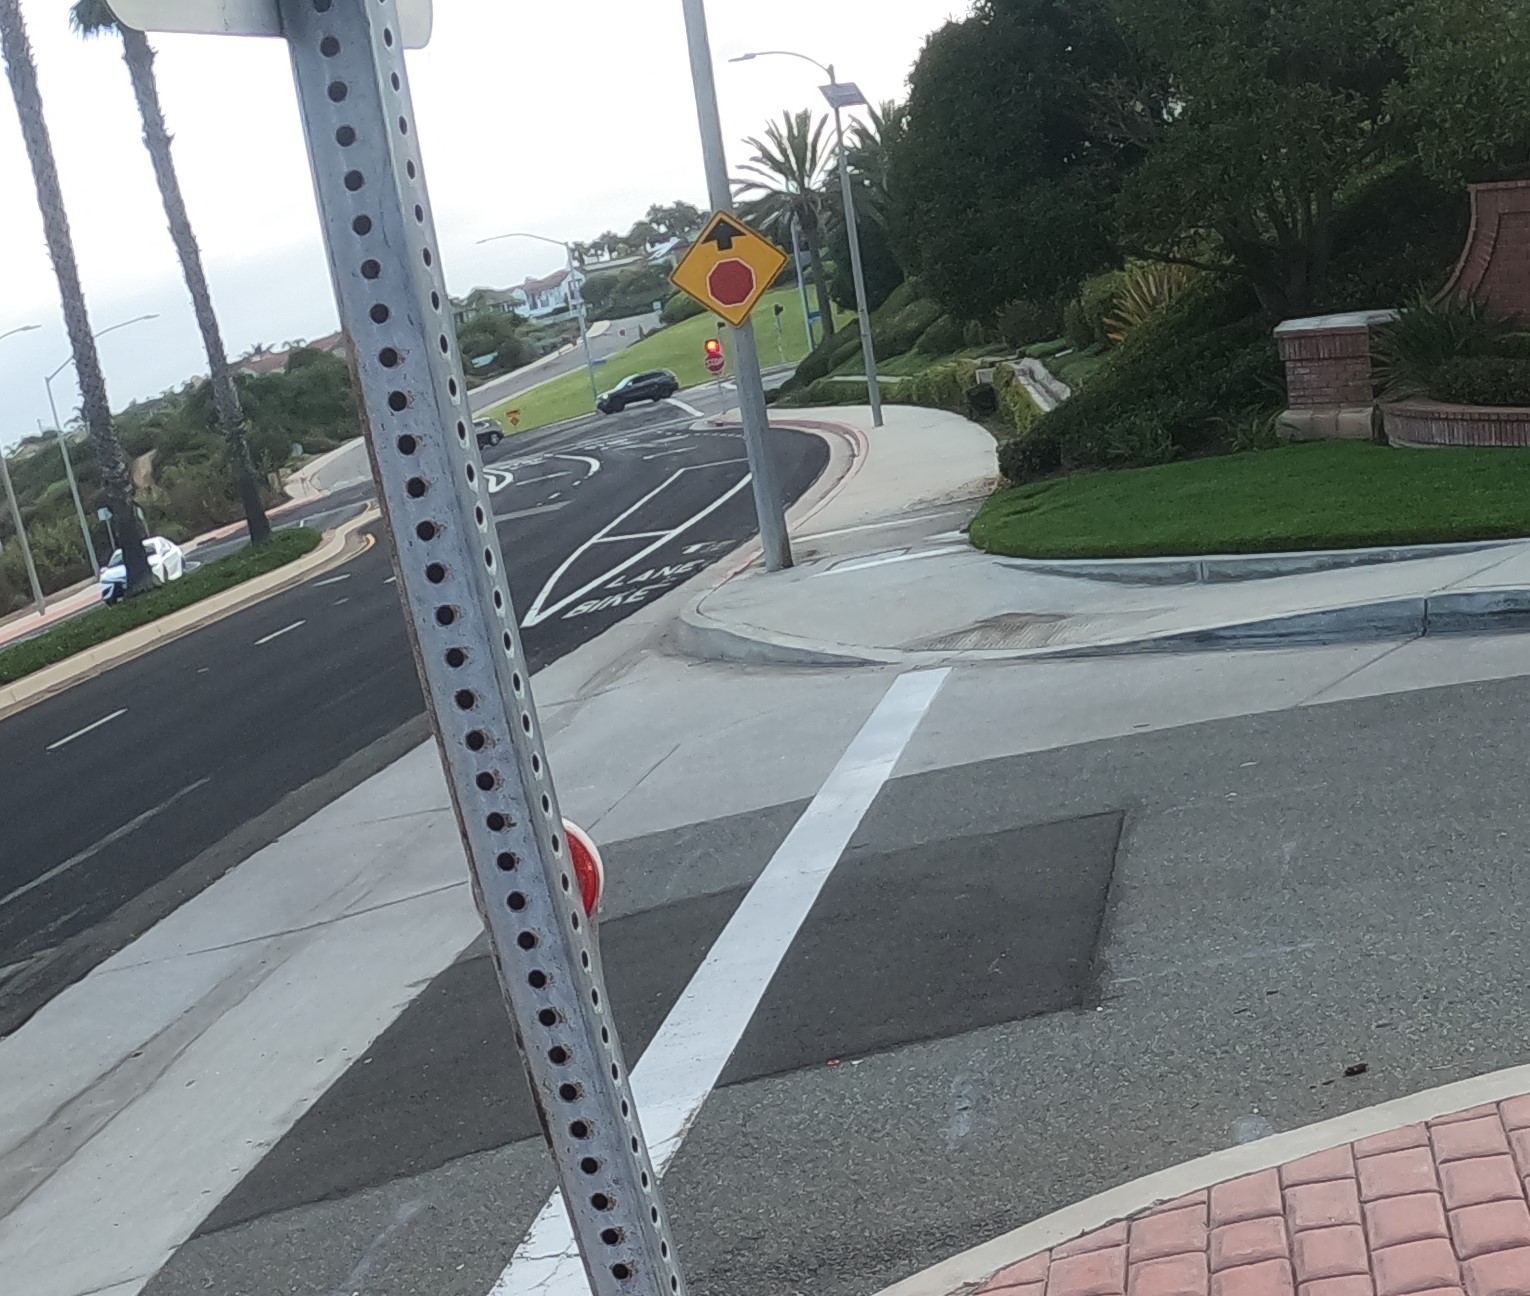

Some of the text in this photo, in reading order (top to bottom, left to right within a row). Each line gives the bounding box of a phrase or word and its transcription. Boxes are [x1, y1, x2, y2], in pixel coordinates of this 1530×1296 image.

[705, 357, 725, 368] STOP
[604, 559, 706, 589] LANE
[561, 582, 672, 620] BIKE
